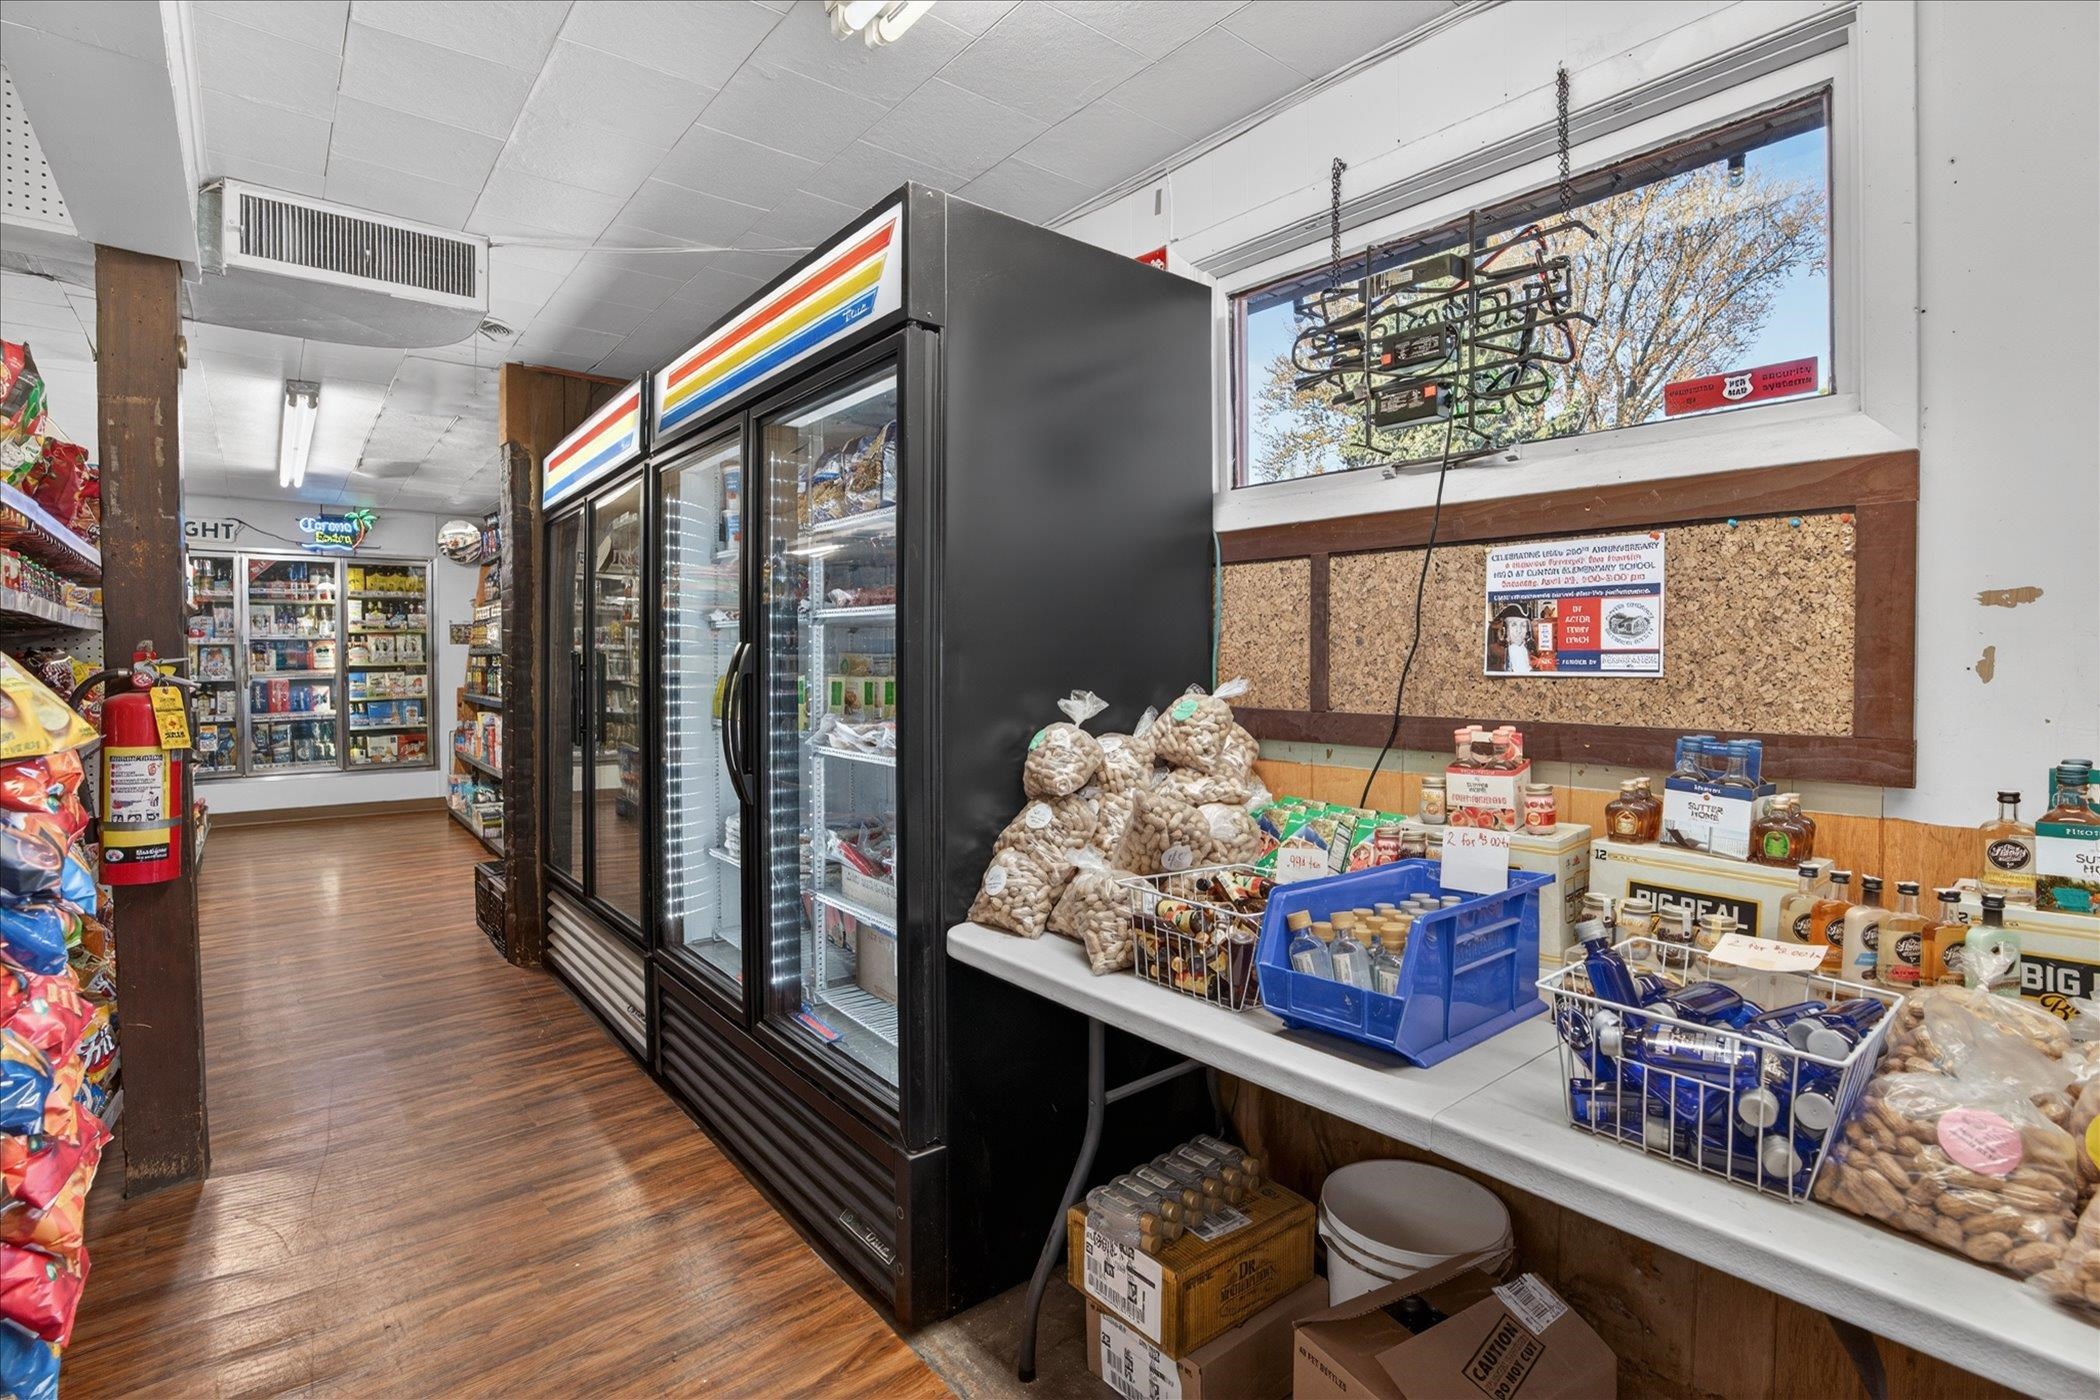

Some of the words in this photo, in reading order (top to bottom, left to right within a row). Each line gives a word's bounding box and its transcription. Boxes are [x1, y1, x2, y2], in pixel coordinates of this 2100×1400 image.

[299, 517, 353, 533] Corona
[315, 531, 353, 544] Extra
[1618, 562, 1656, 571] SCHOOL
[1565, 615, 1591, 623] ACTOR
[1688, 801, 1724, 815] SUTTER
[1690, 811, 1720, 821] HOME
[1446, 831, 1456, 846] 2
[1461, 832, 1476, 847] for
[1594, 849, 1607, 861] 12
[2020, 961, 2081, 996] BIG
[1472, 1322, 1519, 1382] CAUTION
[1494, 1382, 1510, 1400] DO
[1505, 1359, 1525, 1384] NOT
[1520, 1341, 1538, 1362] CUT
